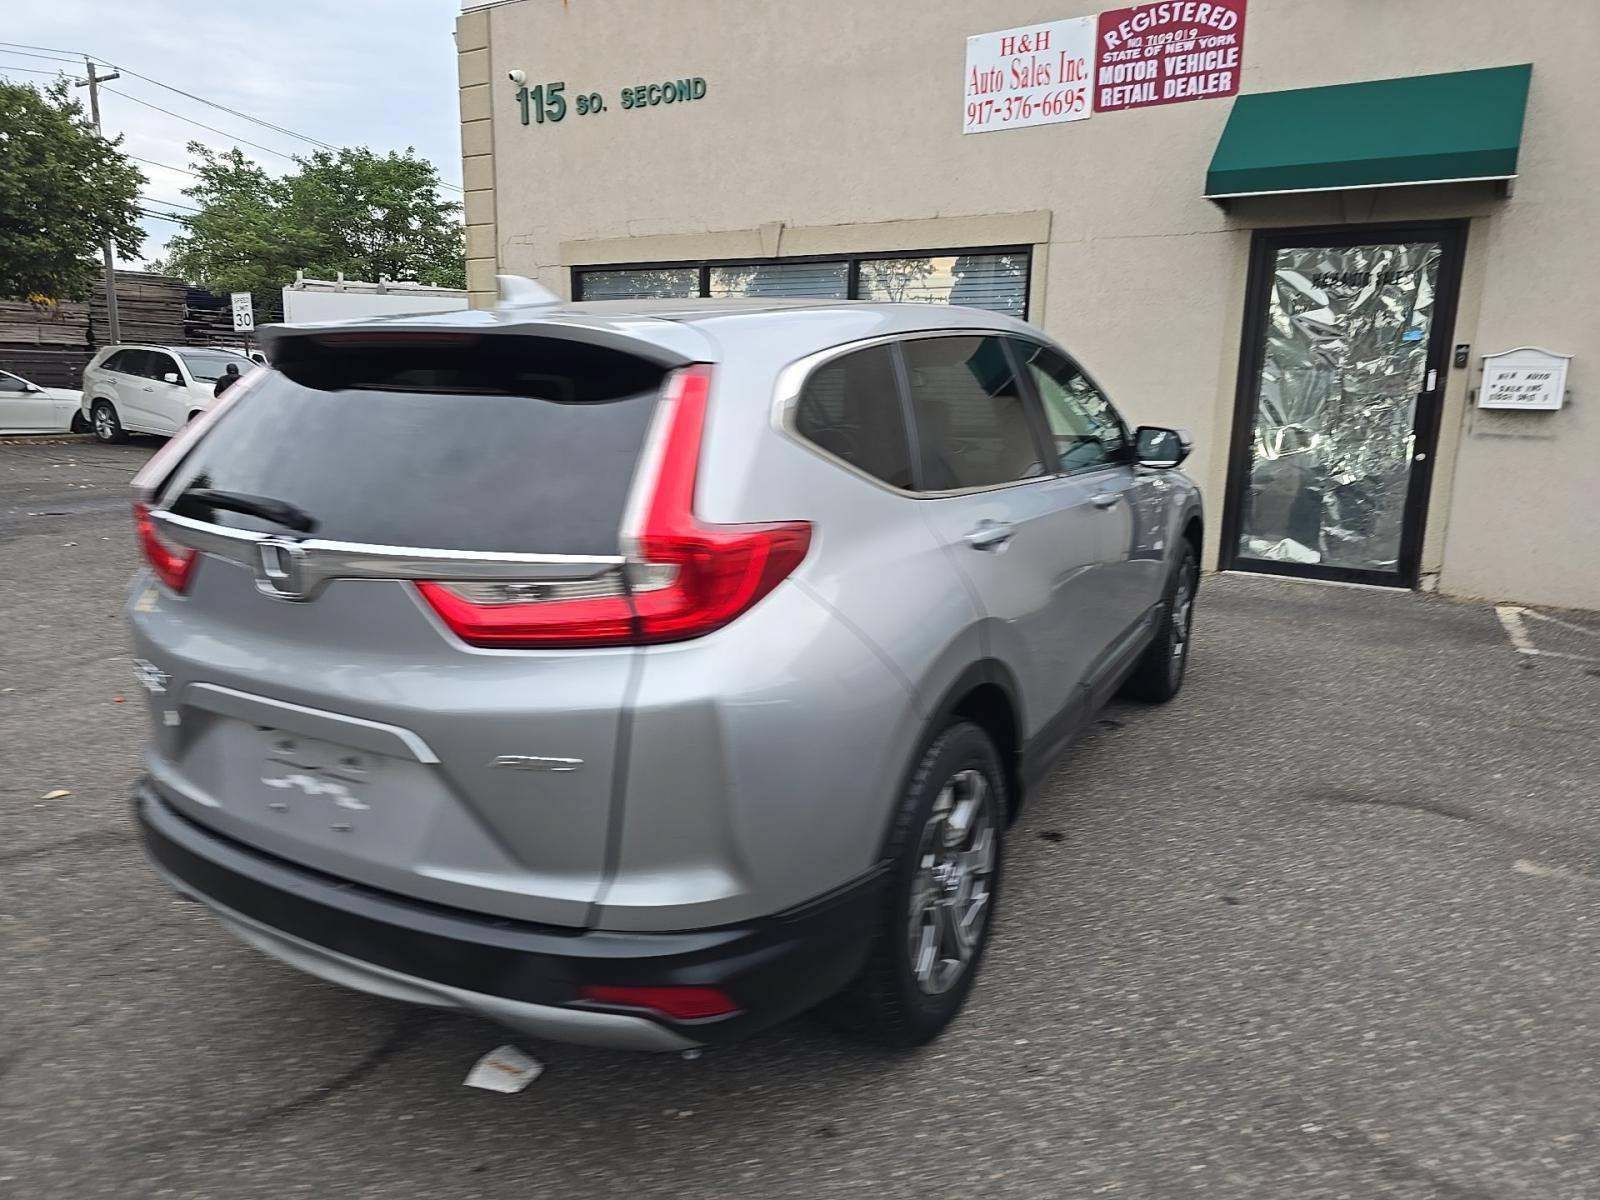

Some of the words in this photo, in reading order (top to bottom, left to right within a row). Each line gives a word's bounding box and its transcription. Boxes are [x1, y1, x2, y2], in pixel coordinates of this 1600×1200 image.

[1000, 31, 1051, 56] H&H
[1104, 2, 1238, 49] REGISTERED
[1098, 59, 1158, 85] MOTOR
[1164, 47, 1239, 76] VEHICLE
[1103, 48, 1141, 62] STATE
[1144, 45, 1163, 57] OF
[1165, 40, 1195, 54] NEW
[1198, 33, 1236, 49] YORK
[967, 64, 1004, 96] Auto
[1009, 55, 1051, 90] Sales
[1057, 50, 1088, 83] Inc.
[1101, 82, 1158, 107] RETAIL
[1163, 71, 1232, 99] DEALER
[516, 81, 567, 125] 115
[576, 92, 608, 116] SO.
[621, 77, 707, 110] SECOND
[967, 88, 1087, 125] 917-376-6695
[236, 313, 252, 327] 30
